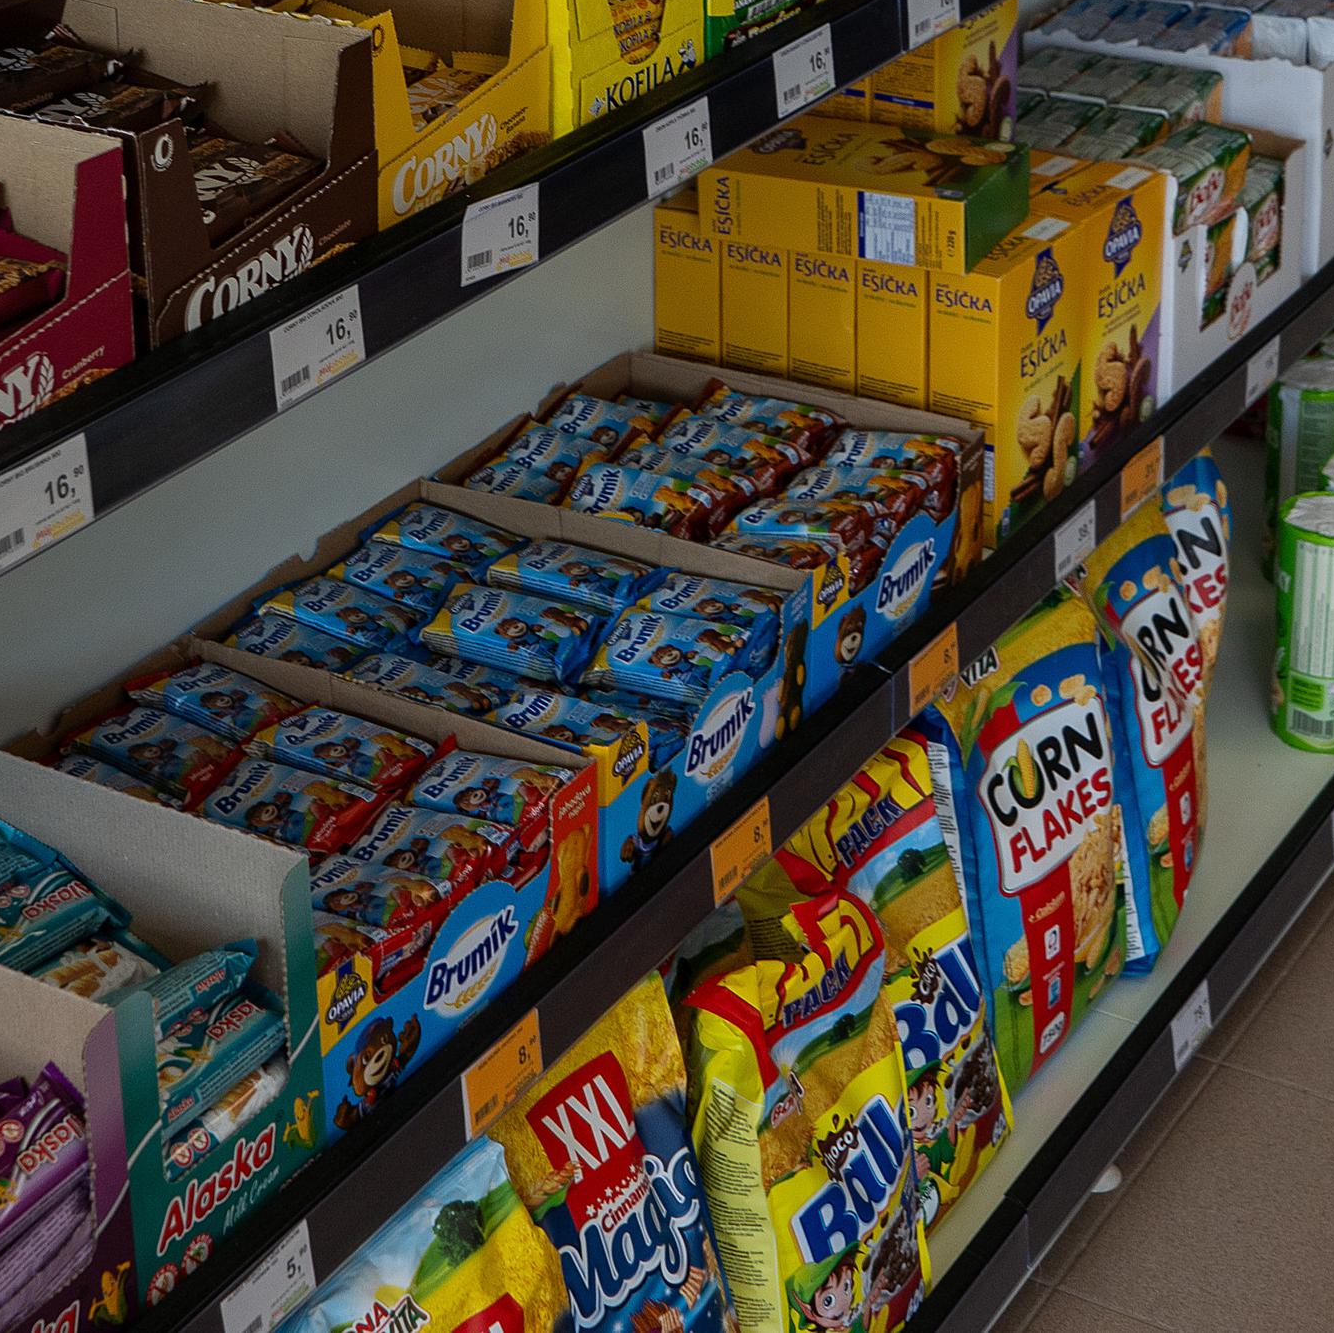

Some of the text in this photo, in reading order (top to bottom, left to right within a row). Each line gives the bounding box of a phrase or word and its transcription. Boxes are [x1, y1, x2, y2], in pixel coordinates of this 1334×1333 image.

[604, 56, 675, 113] KOFILA
[683, 126, 704, 150] 16,
[392, 113, 495, 216] CORNY
[508, 215, 529, 238] 16,
[717, 176, 732, 236] ESÍČKA
[659, 230, 714, 254] ESÍČKA
[727, 242, 782, 268] ESÍČKA
[184, 223, 307, 333] CORNY
[794, 256, 850, 283] ESÍČKA
[861, 271, 919, 298] ESÍČKA
[935, 286, 992, 314] ESÍČKA
[1027, 281, 1064, 316] OPAVIA
[1097, 272, 1147, 320] ESÍČKA
[325, 316, 352, 346] 16,
[1020, 328, 1068, 380] ESÍČKA
[60, 344, 107, 380] Cranberry
[44, 474, 76, 505] 16,
[878, 538, 937, 614] Brumík
[464, 586, 503, 635] Brumík
[617, 613, 663, 665] Brumík
[685, 691, 754, 770] Brumík
[215, 762, 273, 816] Brumík
[423, 754, 483, 802] Brumík
[985, 712, 1105, 829] CORN
[354, 804, 413, 863] Brumík
[835, 792, 906, 869] PACK
[1006, 765, 1115, 877] FLAKES
[423, 904, 518, 1011] Brumík
[325, 982, 367, 1028] OPAVIA
[782, 952, 852, 1028] PACK
[206, 998, 267, 1044] laska
[517, 1045, 531, 1065] 8,
[16, 1116, 85, 1175] laska
[542, 1074, 635, 1171] XXL
[156, 1122, 277, 1258] Alaska
[796, 1094, 908, 1266] Ball
[559, 1149, 701, 1324] Magic
[286, 1257, 303, 1280] 5,
